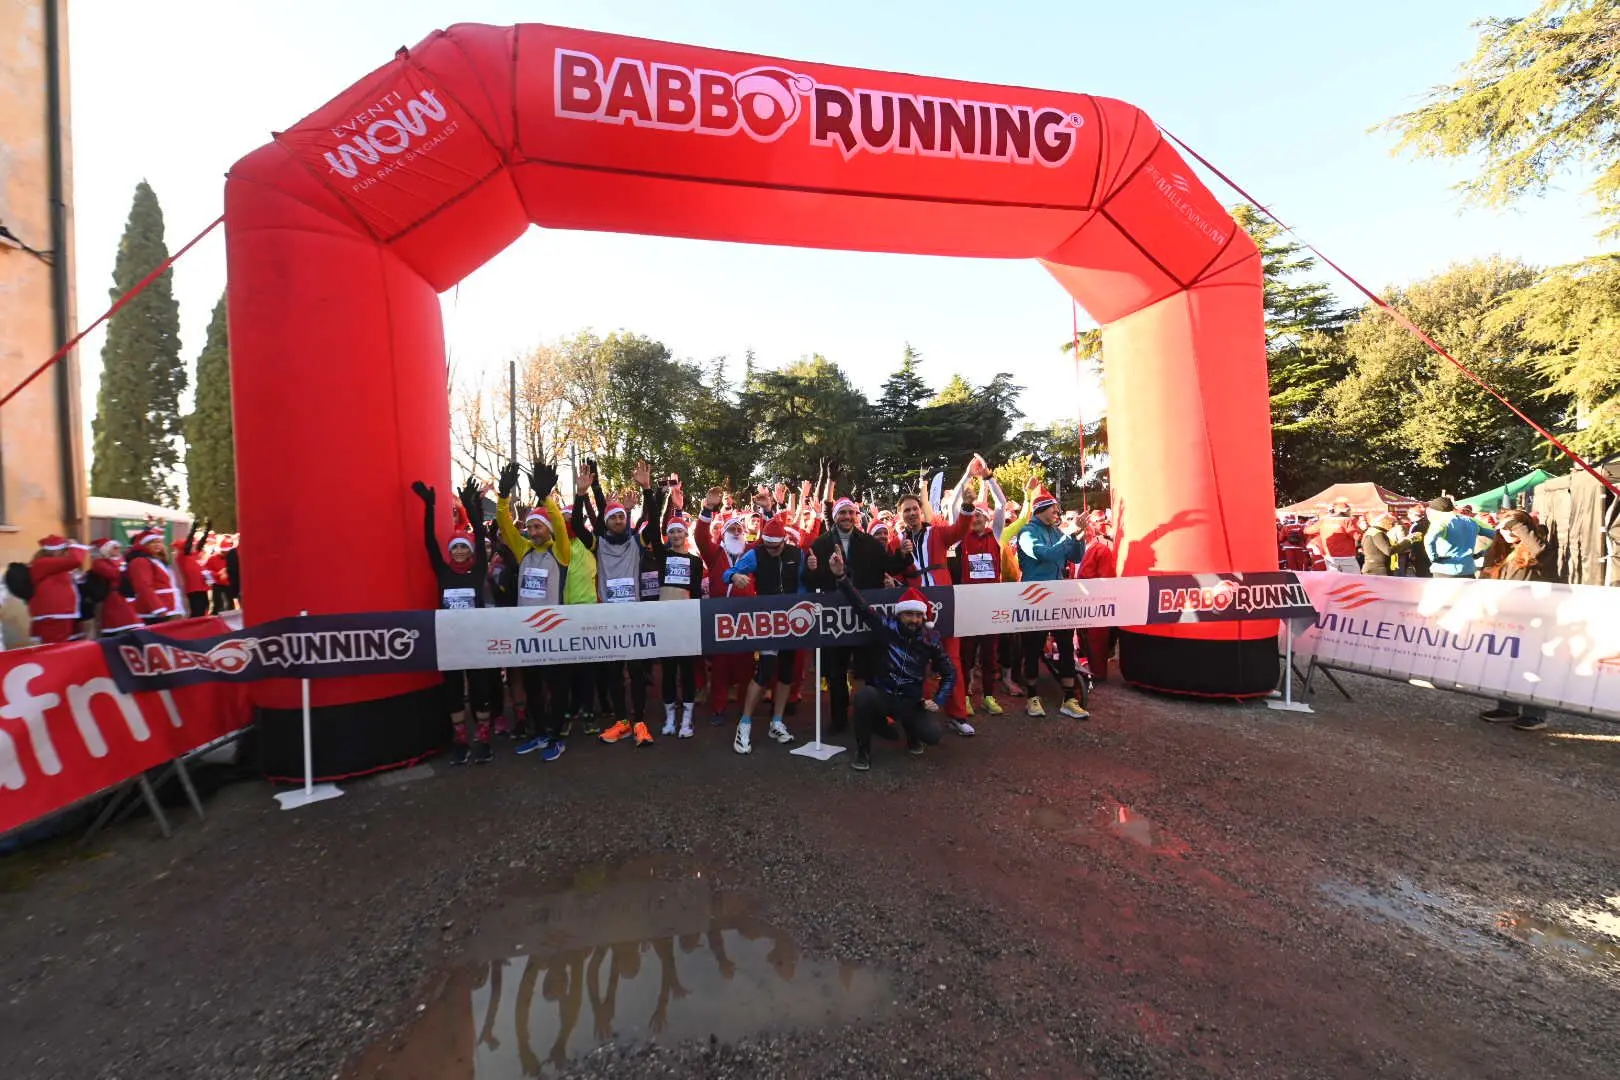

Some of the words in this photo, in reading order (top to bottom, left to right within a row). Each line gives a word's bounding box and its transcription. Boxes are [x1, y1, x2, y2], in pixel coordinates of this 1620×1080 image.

[331, 91, 402, 138] EVENTI
[554, 48, 802, 143] BABBO
[323, 89, 447, 178] WOW
[715, 601, 816, 641] BABBO
[1012, 603, 1116, 623] MILLENNIUM
[487, 639, 512, 651] 25
[515, 631, 657, 654] MILLENNIUM
